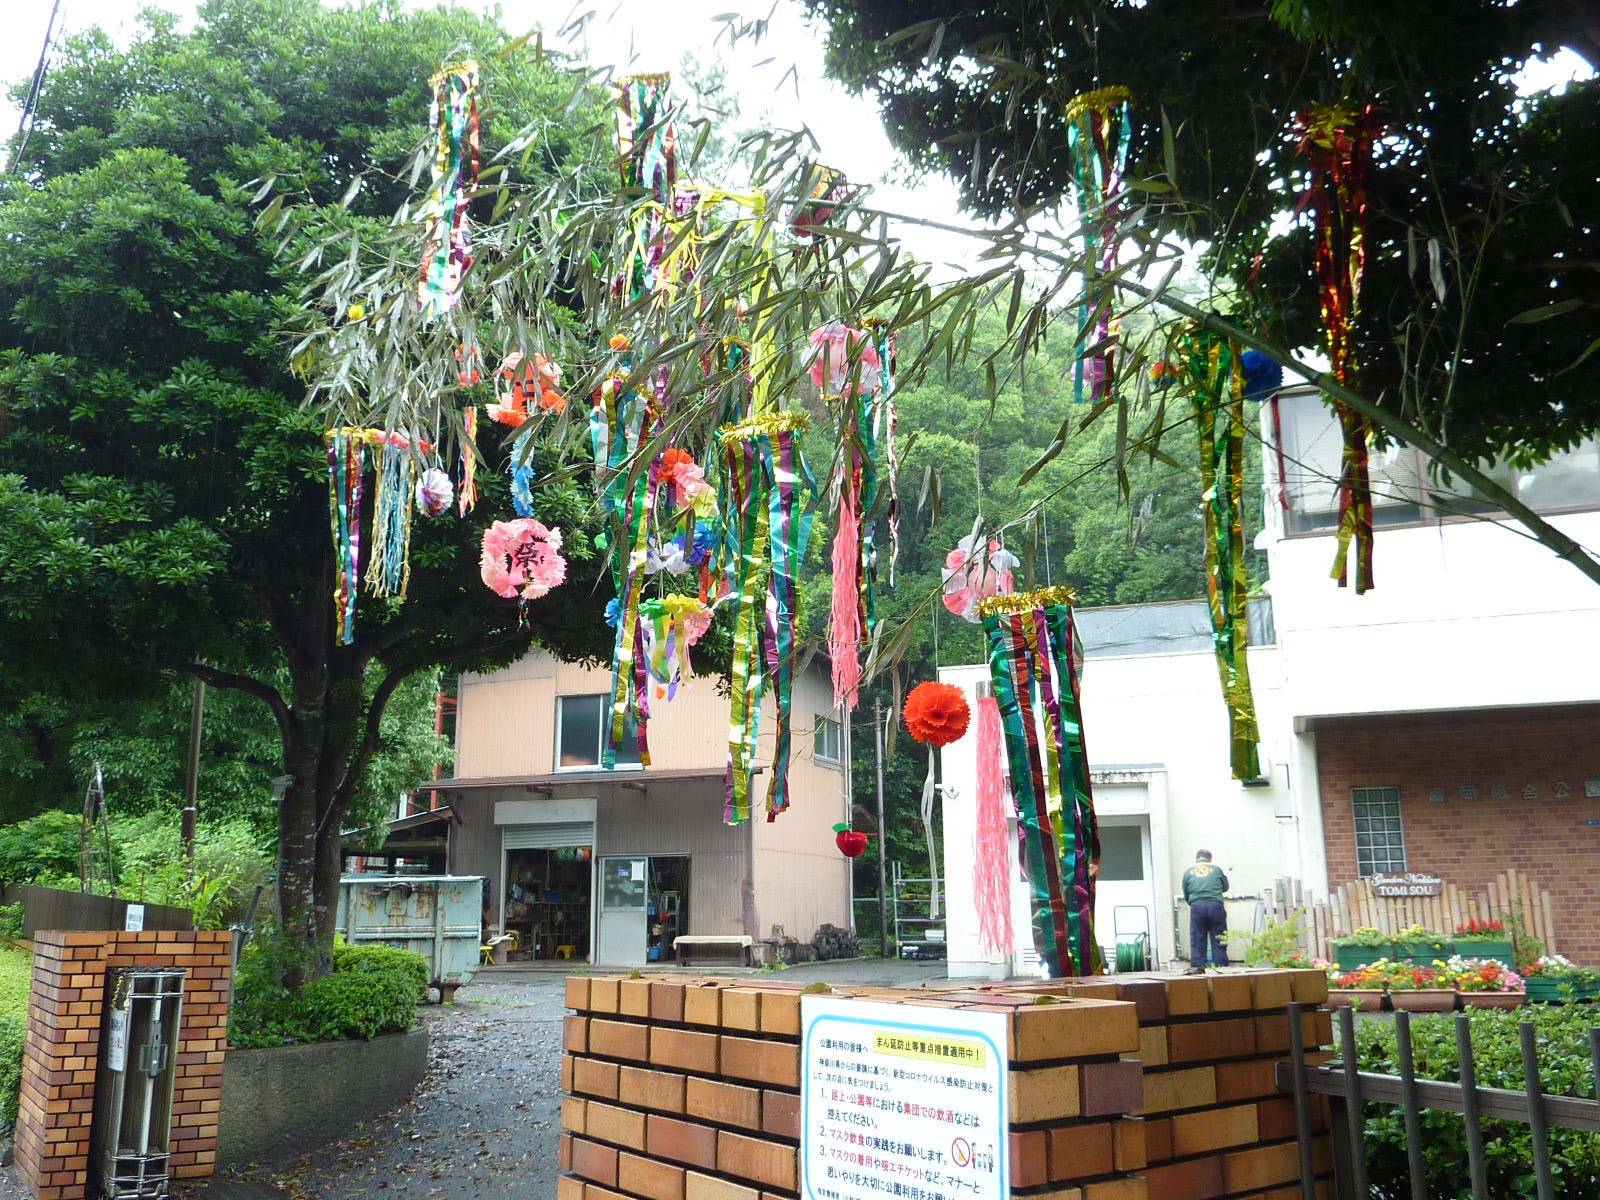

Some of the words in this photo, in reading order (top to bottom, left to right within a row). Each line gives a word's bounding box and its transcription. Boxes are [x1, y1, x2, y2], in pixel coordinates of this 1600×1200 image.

[514, 541, 539, 568] 祭
[1378, 886, 1407, 896] TOMI
[1409, 886, 1432, 895] SOU
[819, 1038, 869, 1054] 公園利用の皆様へ
[827, 1108, 878, 1129] 控えてください。
